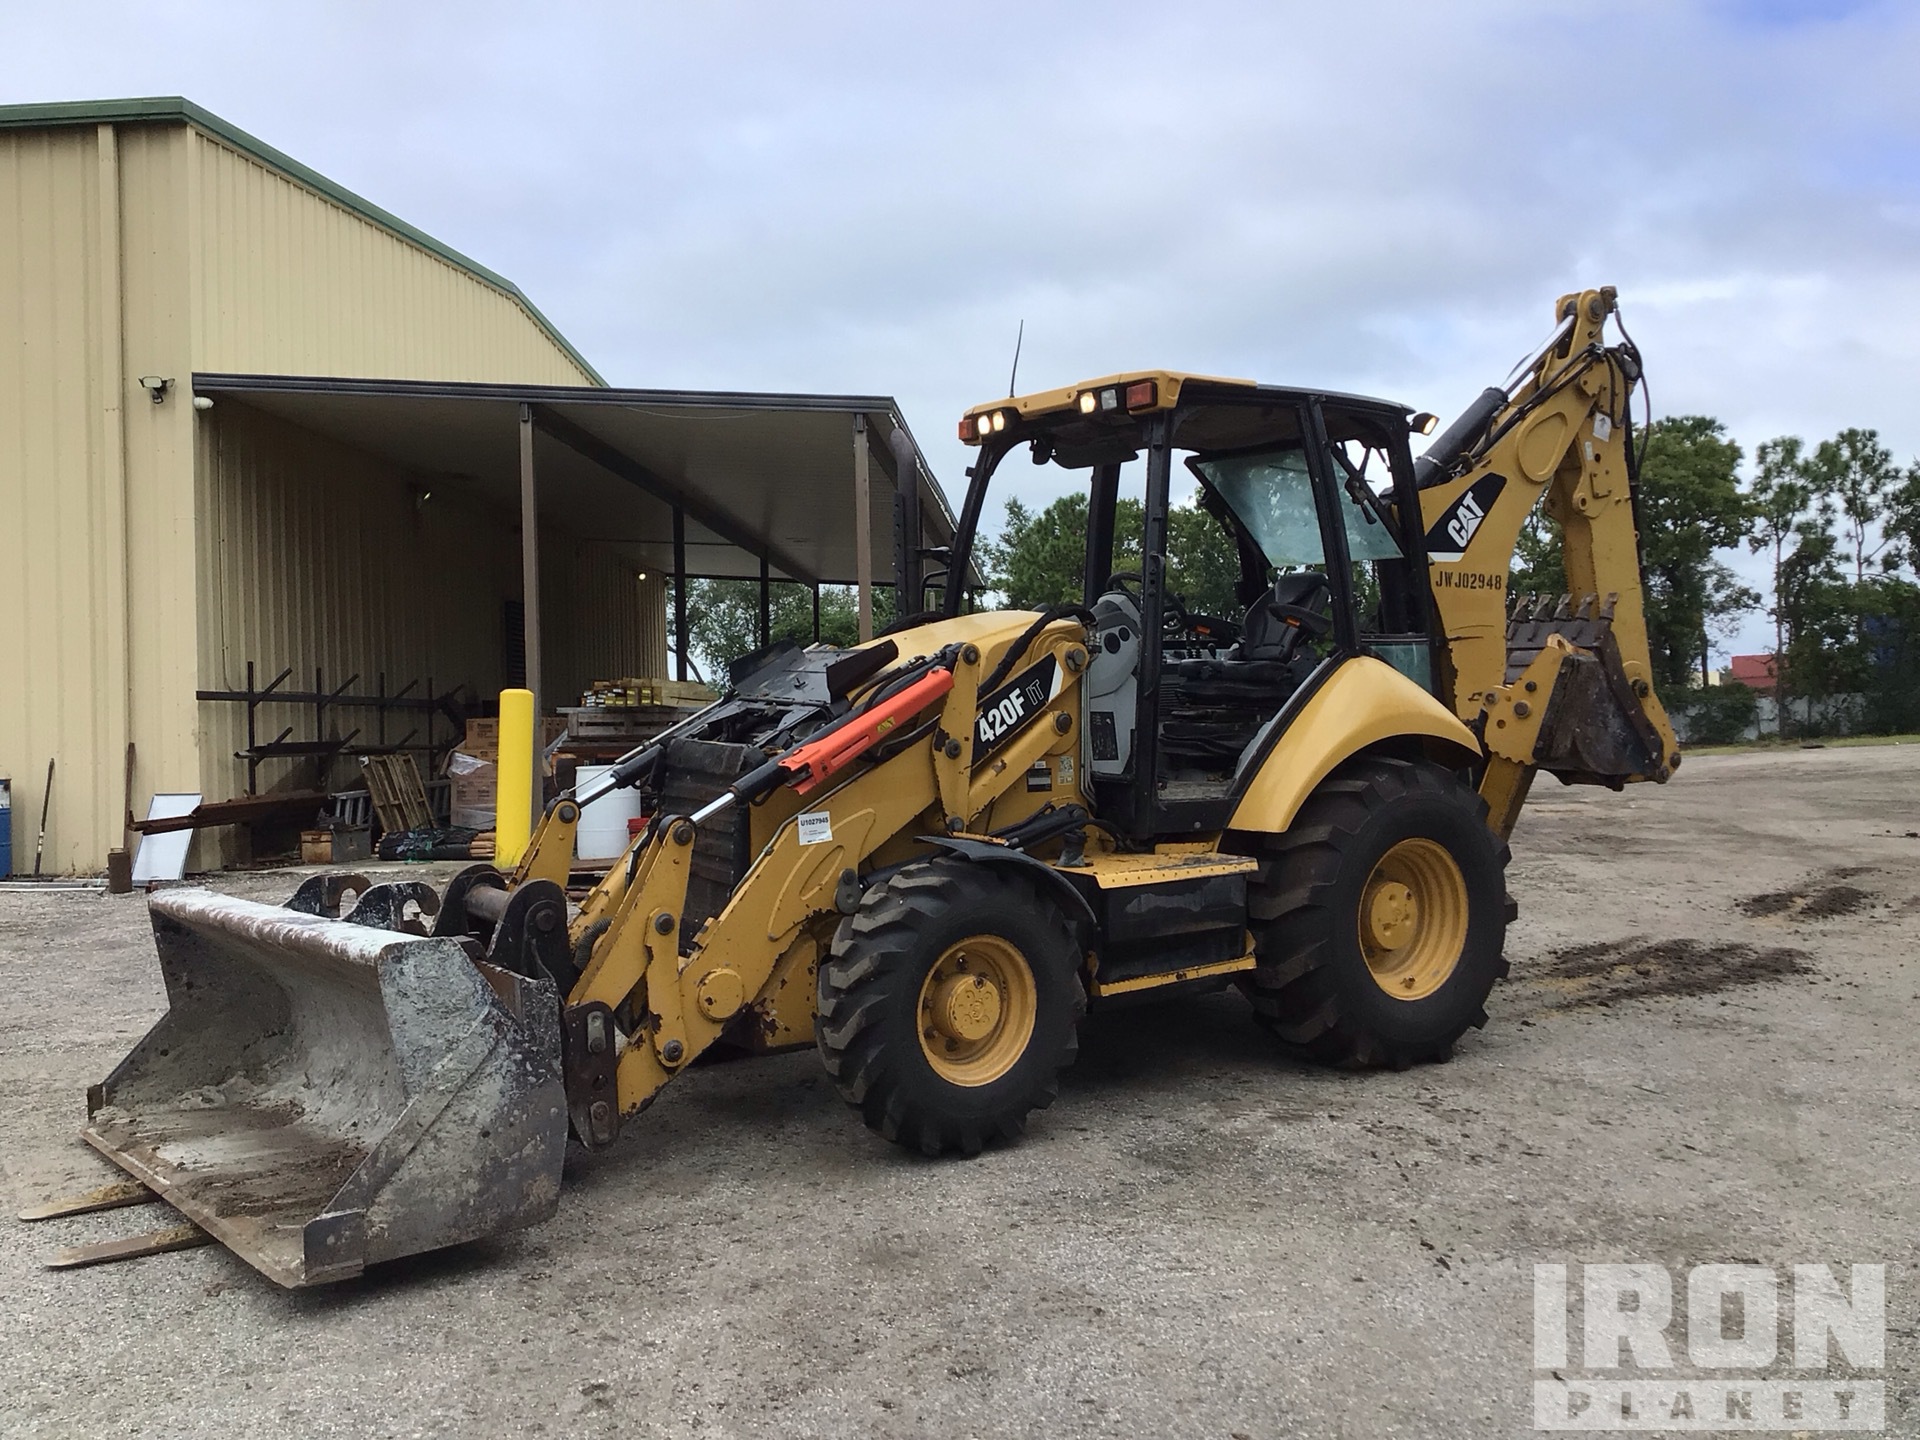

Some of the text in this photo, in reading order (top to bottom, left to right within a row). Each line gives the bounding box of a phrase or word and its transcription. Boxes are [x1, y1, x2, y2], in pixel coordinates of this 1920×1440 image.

[1447, 490, 1484, 548] CAT
[1435, 571, 1502, 590] JWJ02948
[979, 679, 1044, 742] 420F IT
